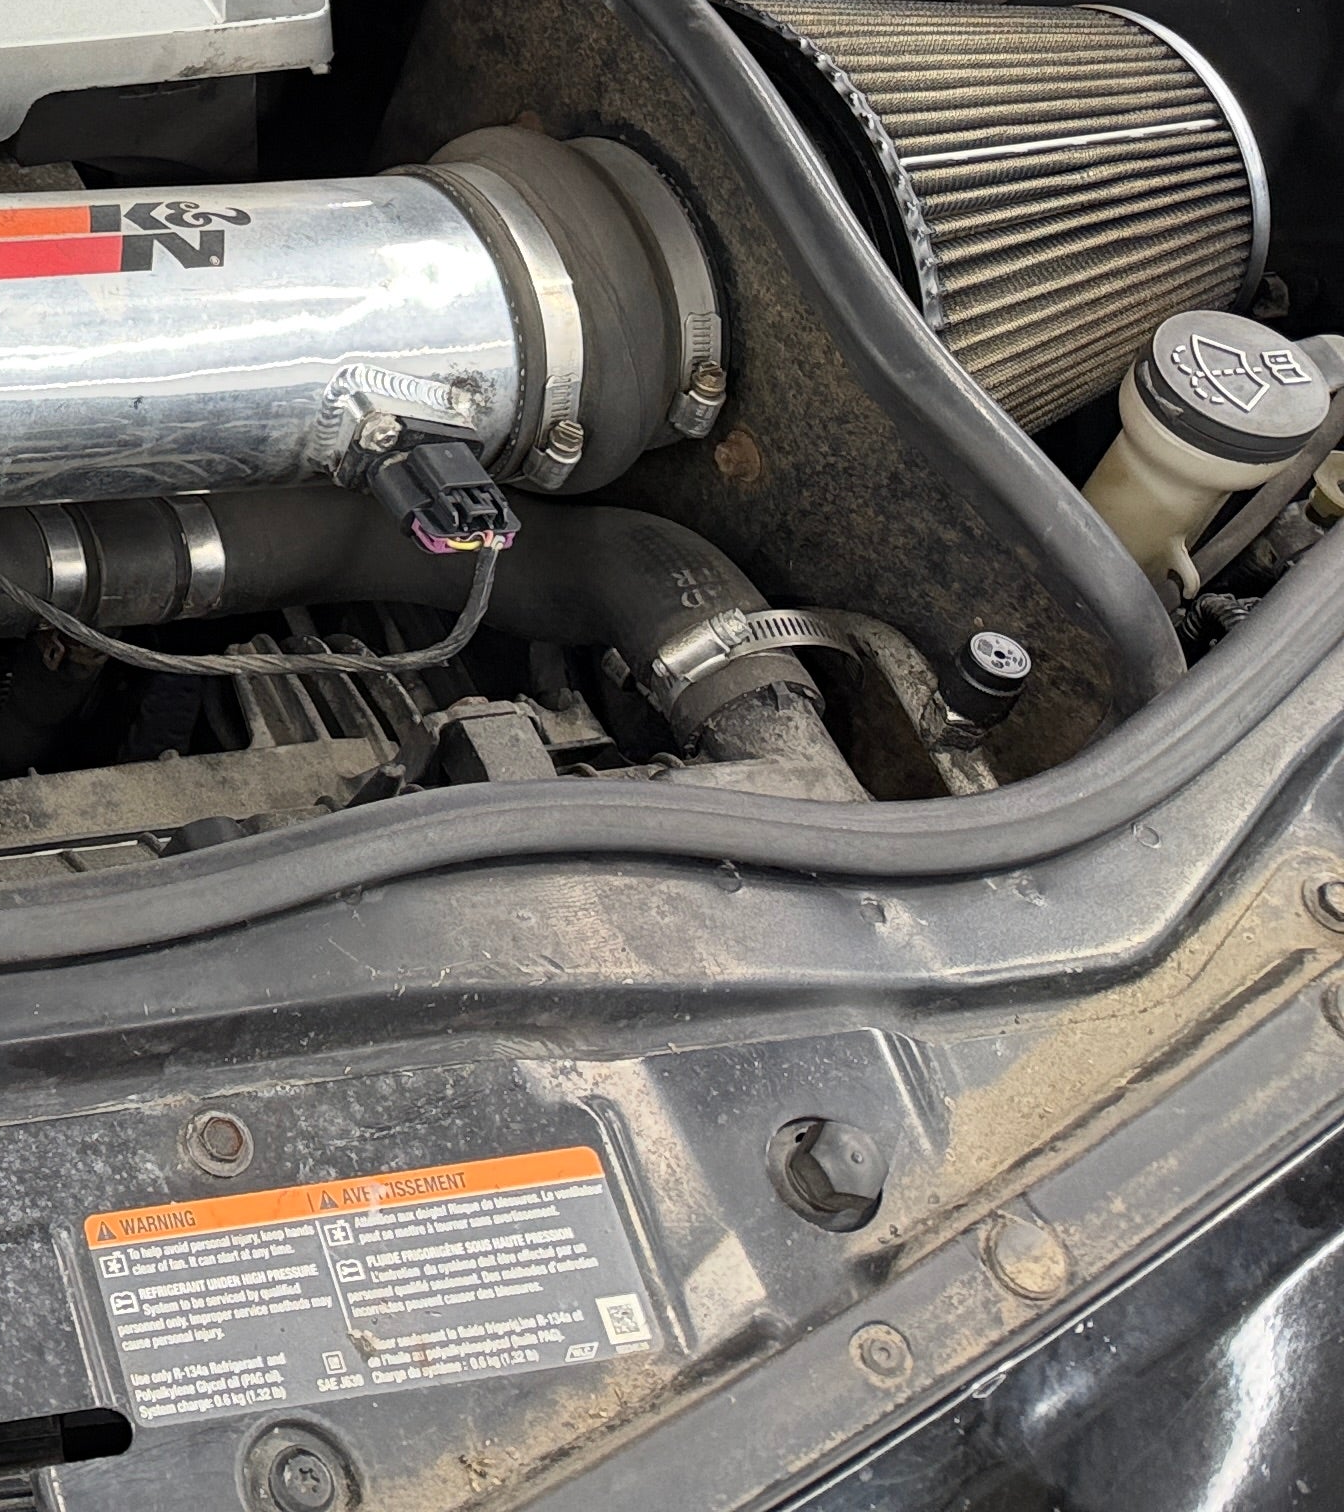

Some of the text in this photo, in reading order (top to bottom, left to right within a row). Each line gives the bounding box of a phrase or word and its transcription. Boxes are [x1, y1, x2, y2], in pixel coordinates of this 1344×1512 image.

[90, 201, 252, 272] K&N
[341, 1174, 467, 1203] AVETISSEMENT
[120, 1211, 195, 1234] WARNING
[353, 1212, 396, 1227] Attion
[541, 1190, 554, 1201] Le
[127, 1249, 139, 1259] To
[141, 1246, 161, 1259] help
[162, 1242, 188, 1254] avoid
[190, 1236, 231, 1252] personal
[260, 1229, 284, 1242] keep
[285, 1225, 313, 1237] hands
[366, 1252, 401, 1266] FLUIDE
[465, 1239, 492, 1252] SOUS
[492, 1235, 525, 1248] HAUTE
[524, 1227, 574, 1243] PRESSION
[132, 1243, 294, 1274] clear of fan. It can start at any time.
[138, 1264, 318, 1299] REFRIGERANT UNDER HIGH PRESSURE
[142, 1283, 301, 1316] System to be serviced by qualified
[117, 1319, 164, 1335] personnel
[189, 1309, 232, 1325] Improper
[233, 1304, 268, 1318] service
[269, 1298, 309, 1313] methods
[311, 1296, 332, 1309] may
[122, 1338, 150, 1350] cause
[151, 1331, 193, 1348] personal
[130, 1353, 285, 1384] Use only R-134a Refrigerant and
[195, 1378, 226, 1394] Glycol
[227, 1376, 239, 1387] oil
[240, 1372, 264, 1387] (PAG
[317, 1378, 337, 1391] SAE
[139, 1402, 175, 1419] System
[214, 1394, 230, 1405] 0.6
[231, 1392, 245, 1406] kg
